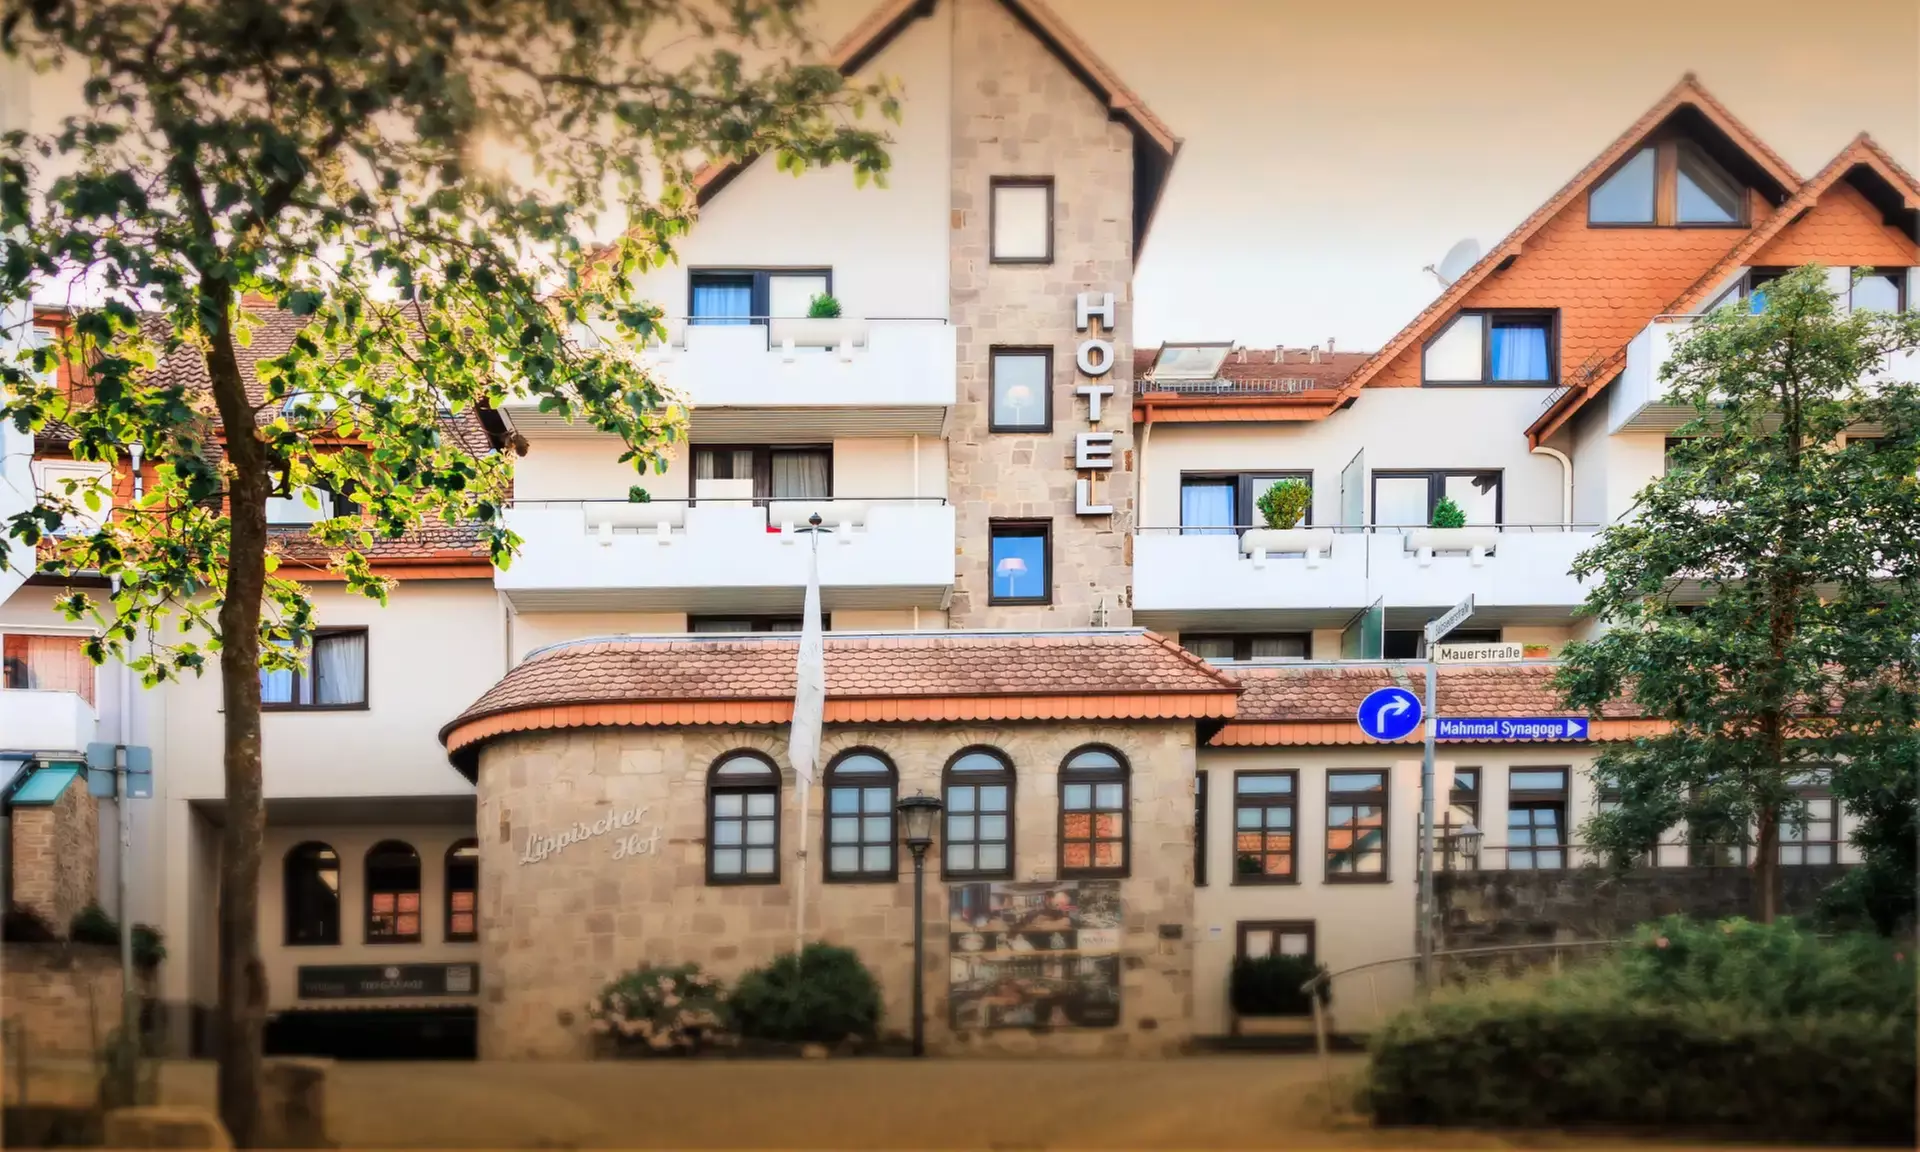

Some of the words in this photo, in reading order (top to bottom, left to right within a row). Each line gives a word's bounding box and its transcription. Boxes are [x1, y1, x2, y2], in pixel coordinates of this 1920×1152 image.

[1076, 292, 1114, 516] HOTEL
[1441, 647, 1520, 660] Mauerstraße
[1440, 721, 1498, 735] Mahnmal
[1501, 721, 1563, 738] Synagoge
[519, 805, 648, 866] Lippischer
[612, 827, 662, 861] Hof
